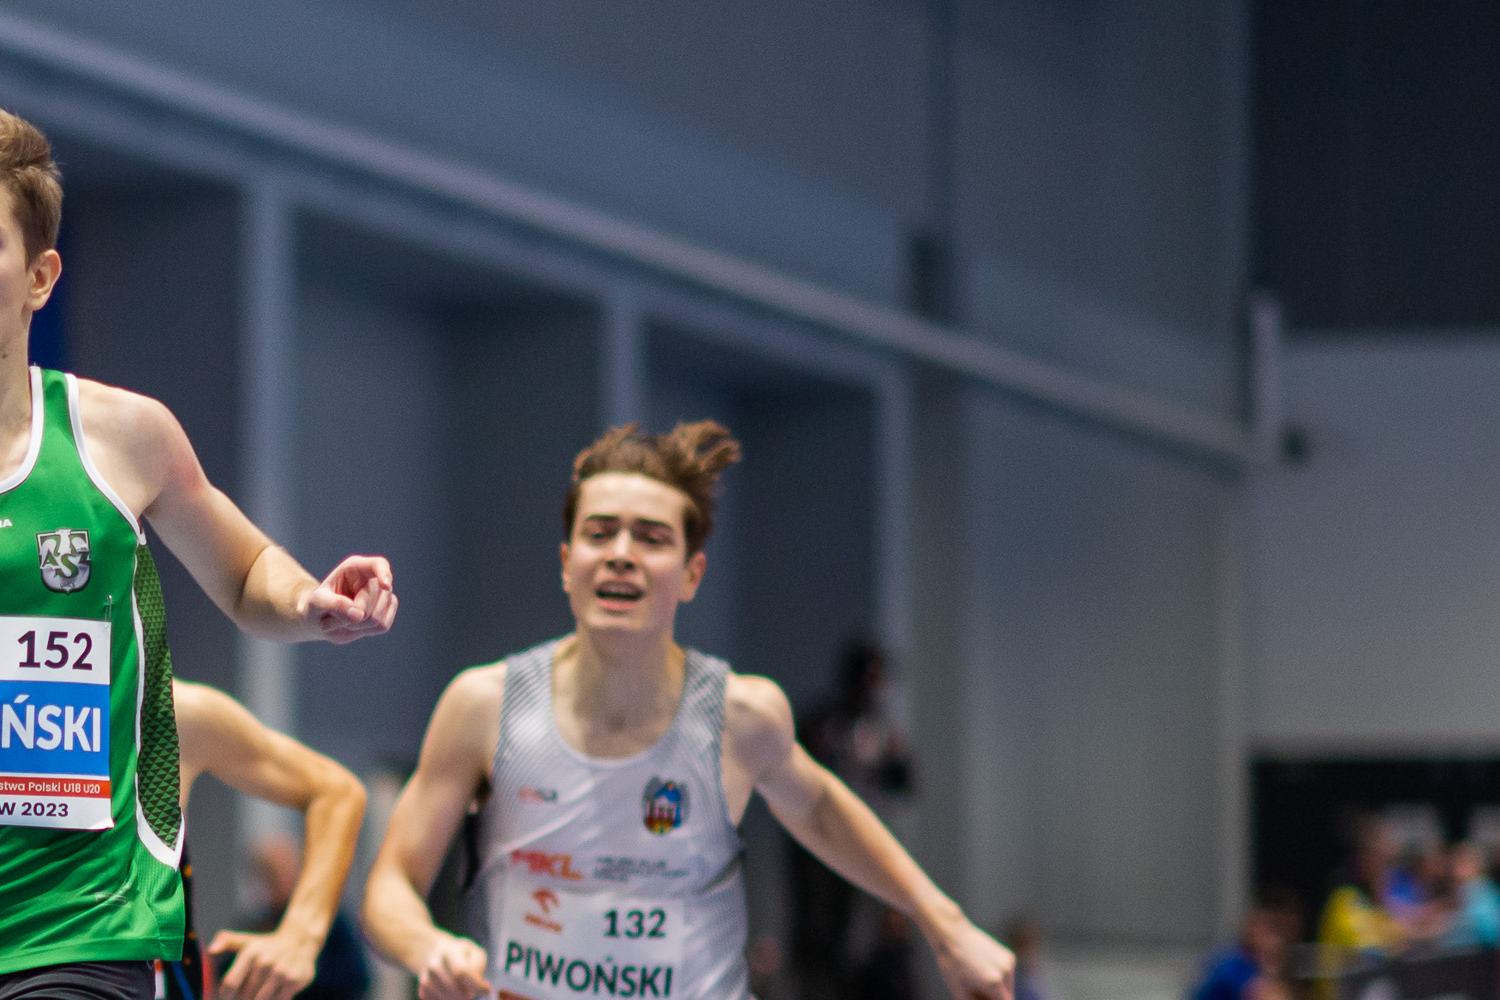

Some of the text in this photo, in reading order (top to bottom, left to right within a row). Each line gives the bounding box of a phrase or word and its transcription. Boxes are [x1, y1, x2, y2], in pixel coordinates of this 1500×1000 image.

[18, 630, 93, 671] 152
[28, 781, 61, 793] Polski
[63, 783, 81, 793] U18
[83, 783, 101, 794] U20
[21, 801, 69, 817] 2023
[603, 908, 667, 939] 132
[505, 941, 673, 998] PIWOŃSKI
